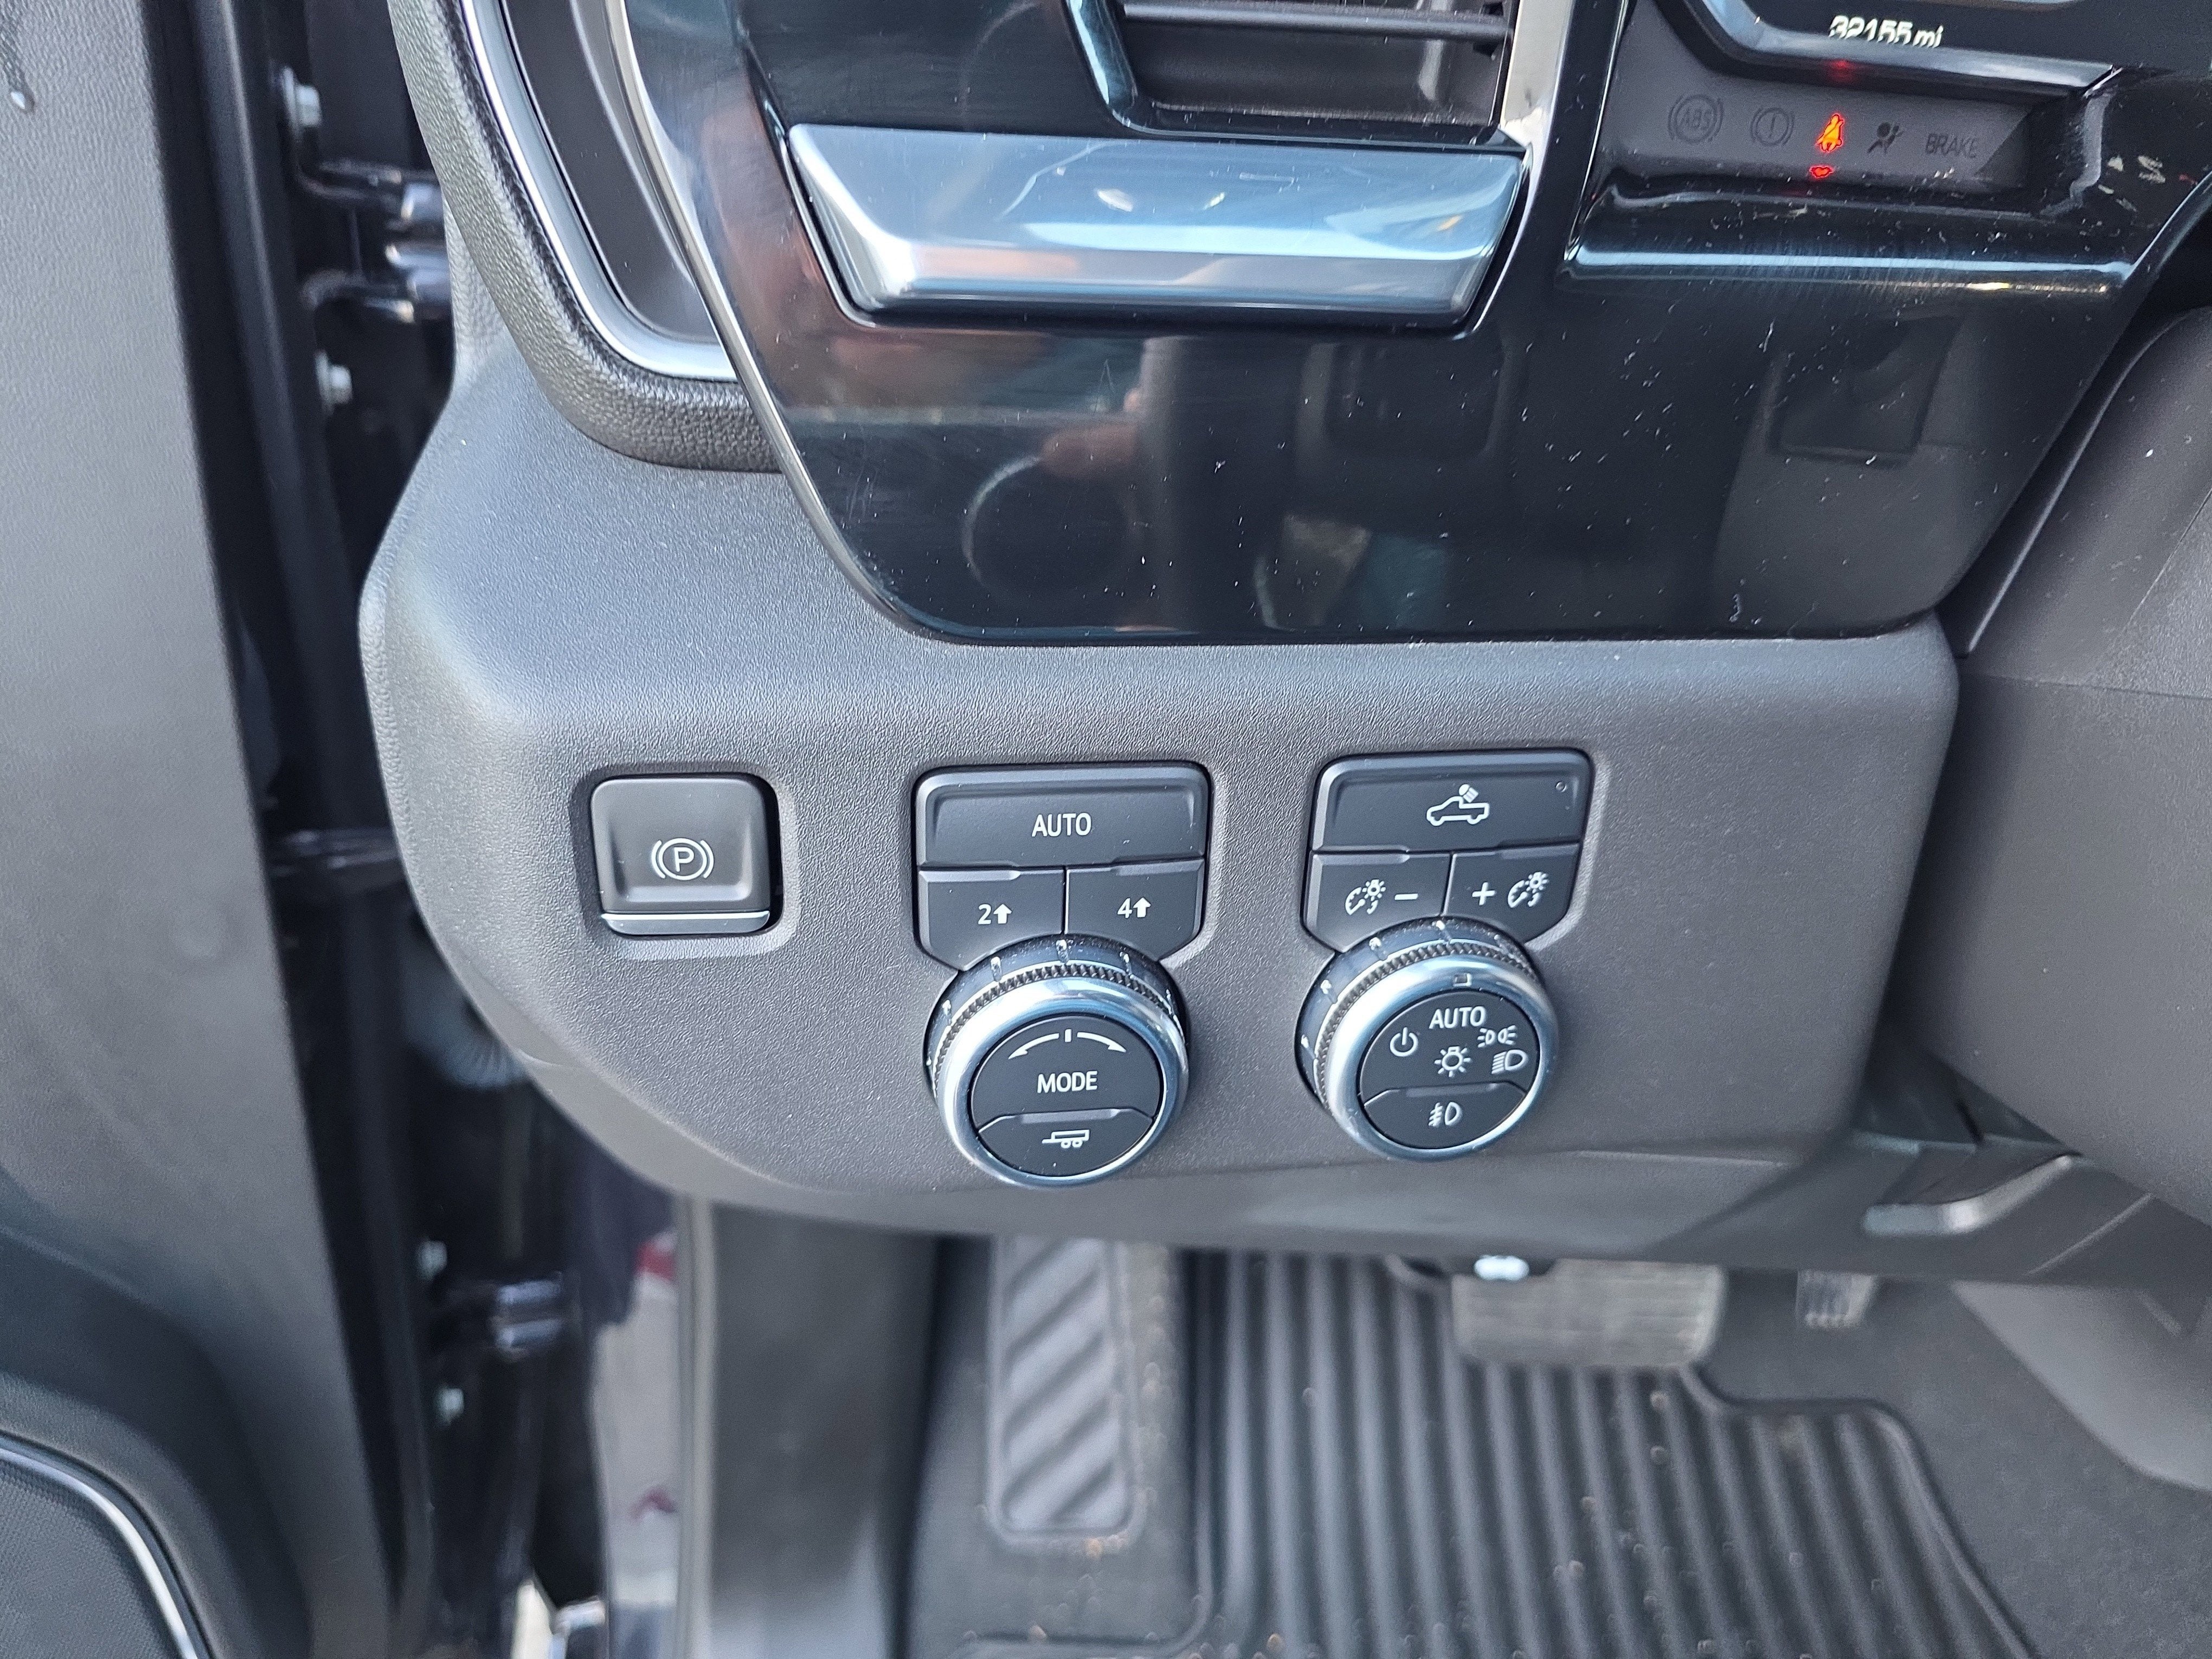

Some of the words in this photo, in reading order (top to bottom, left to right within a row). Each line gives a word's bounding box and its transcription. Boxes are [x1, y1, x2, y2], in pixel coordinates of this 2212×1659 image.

[1913, 25, 1944, 49] mi
[1680, 106, 1713, 132] ABS
[1925, 132, 1978, 158] BRAKE
[1032, 812, 1091, 837] AUTO
[673, 847, 695, 872] P
[1429, 1006, 1485, 1029] AUTO
[1037, 1071, 1098, 1094] MODE
